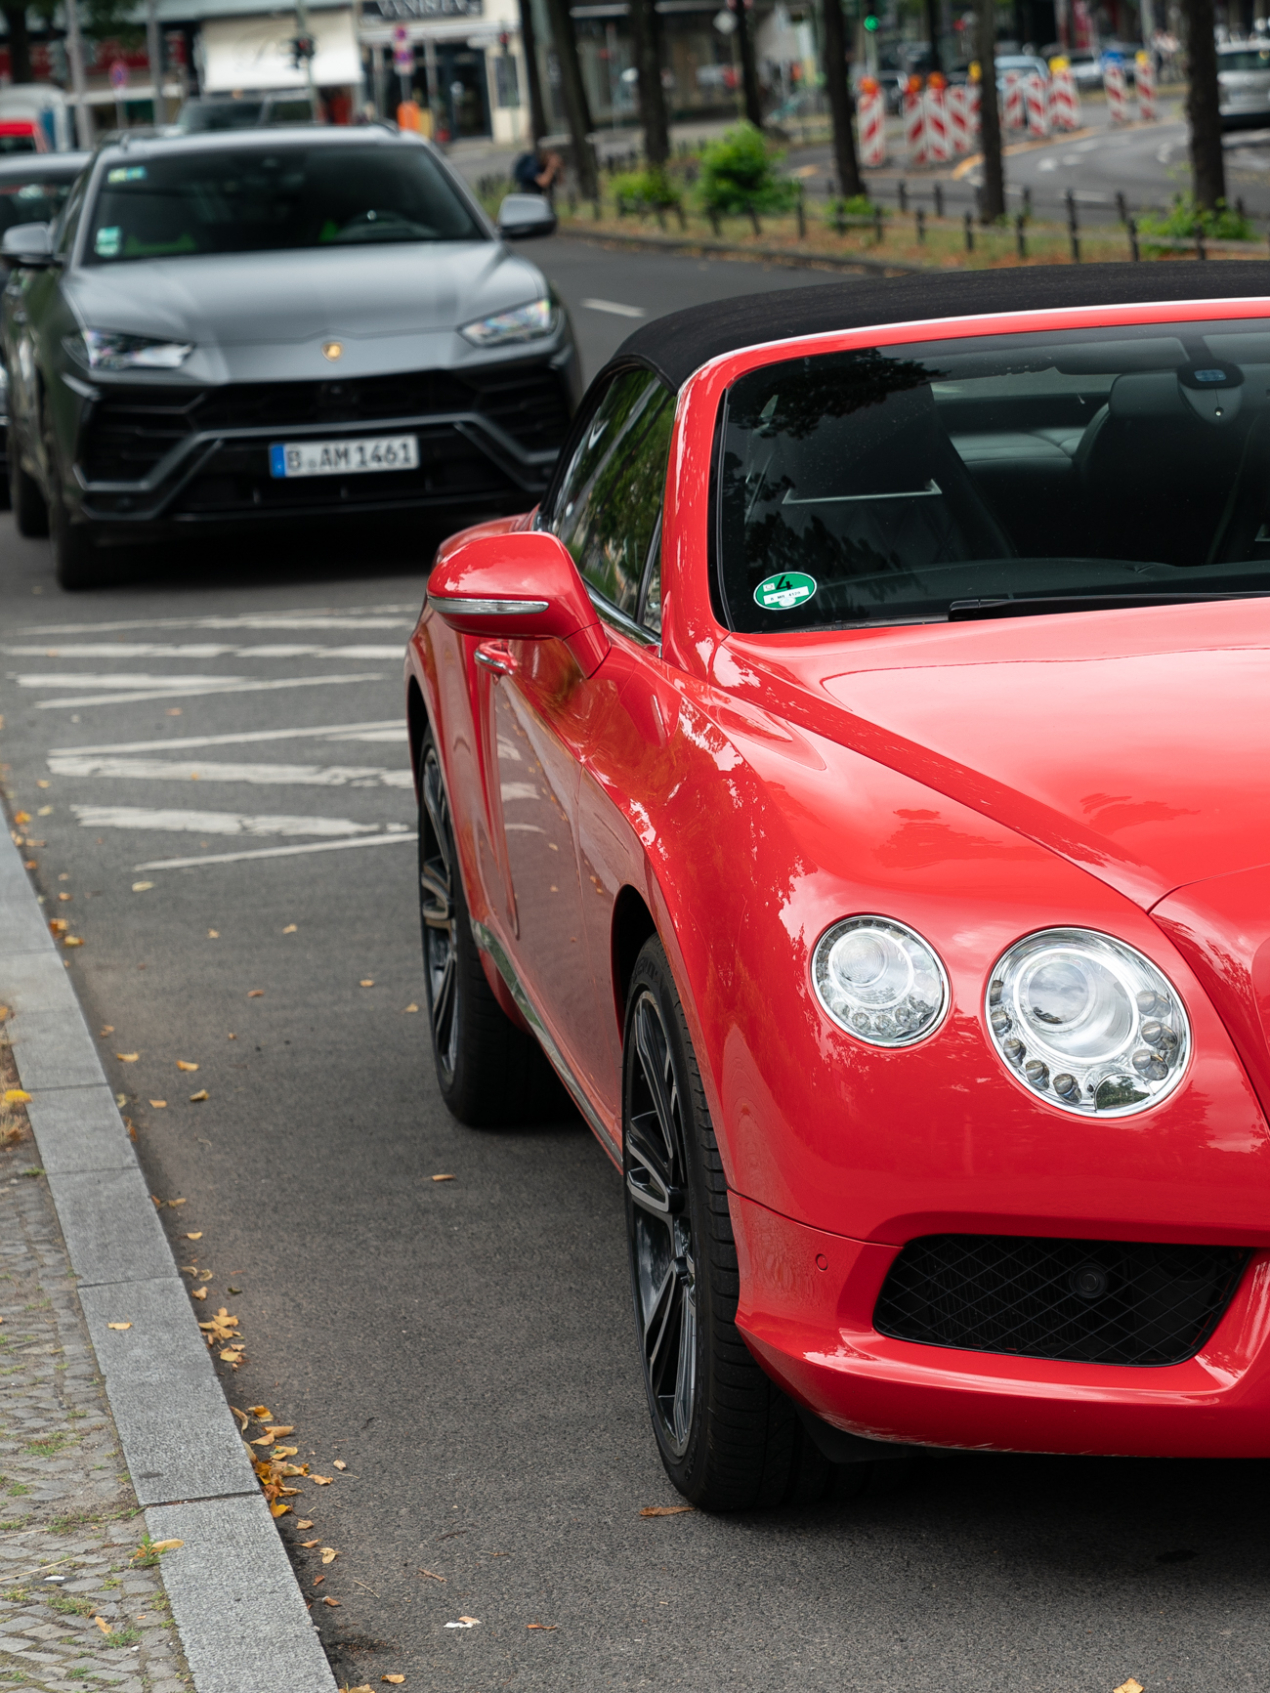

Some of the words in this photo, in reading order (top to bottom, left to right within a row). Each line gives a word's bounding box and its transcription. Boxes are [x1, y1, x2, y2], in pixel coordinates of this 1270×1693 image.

[286, 451, 300, 470] B
[320, 447, 349, 468] AM
[354, 443, 411, 467] 1461
[776, 575, 793, 590] 4
